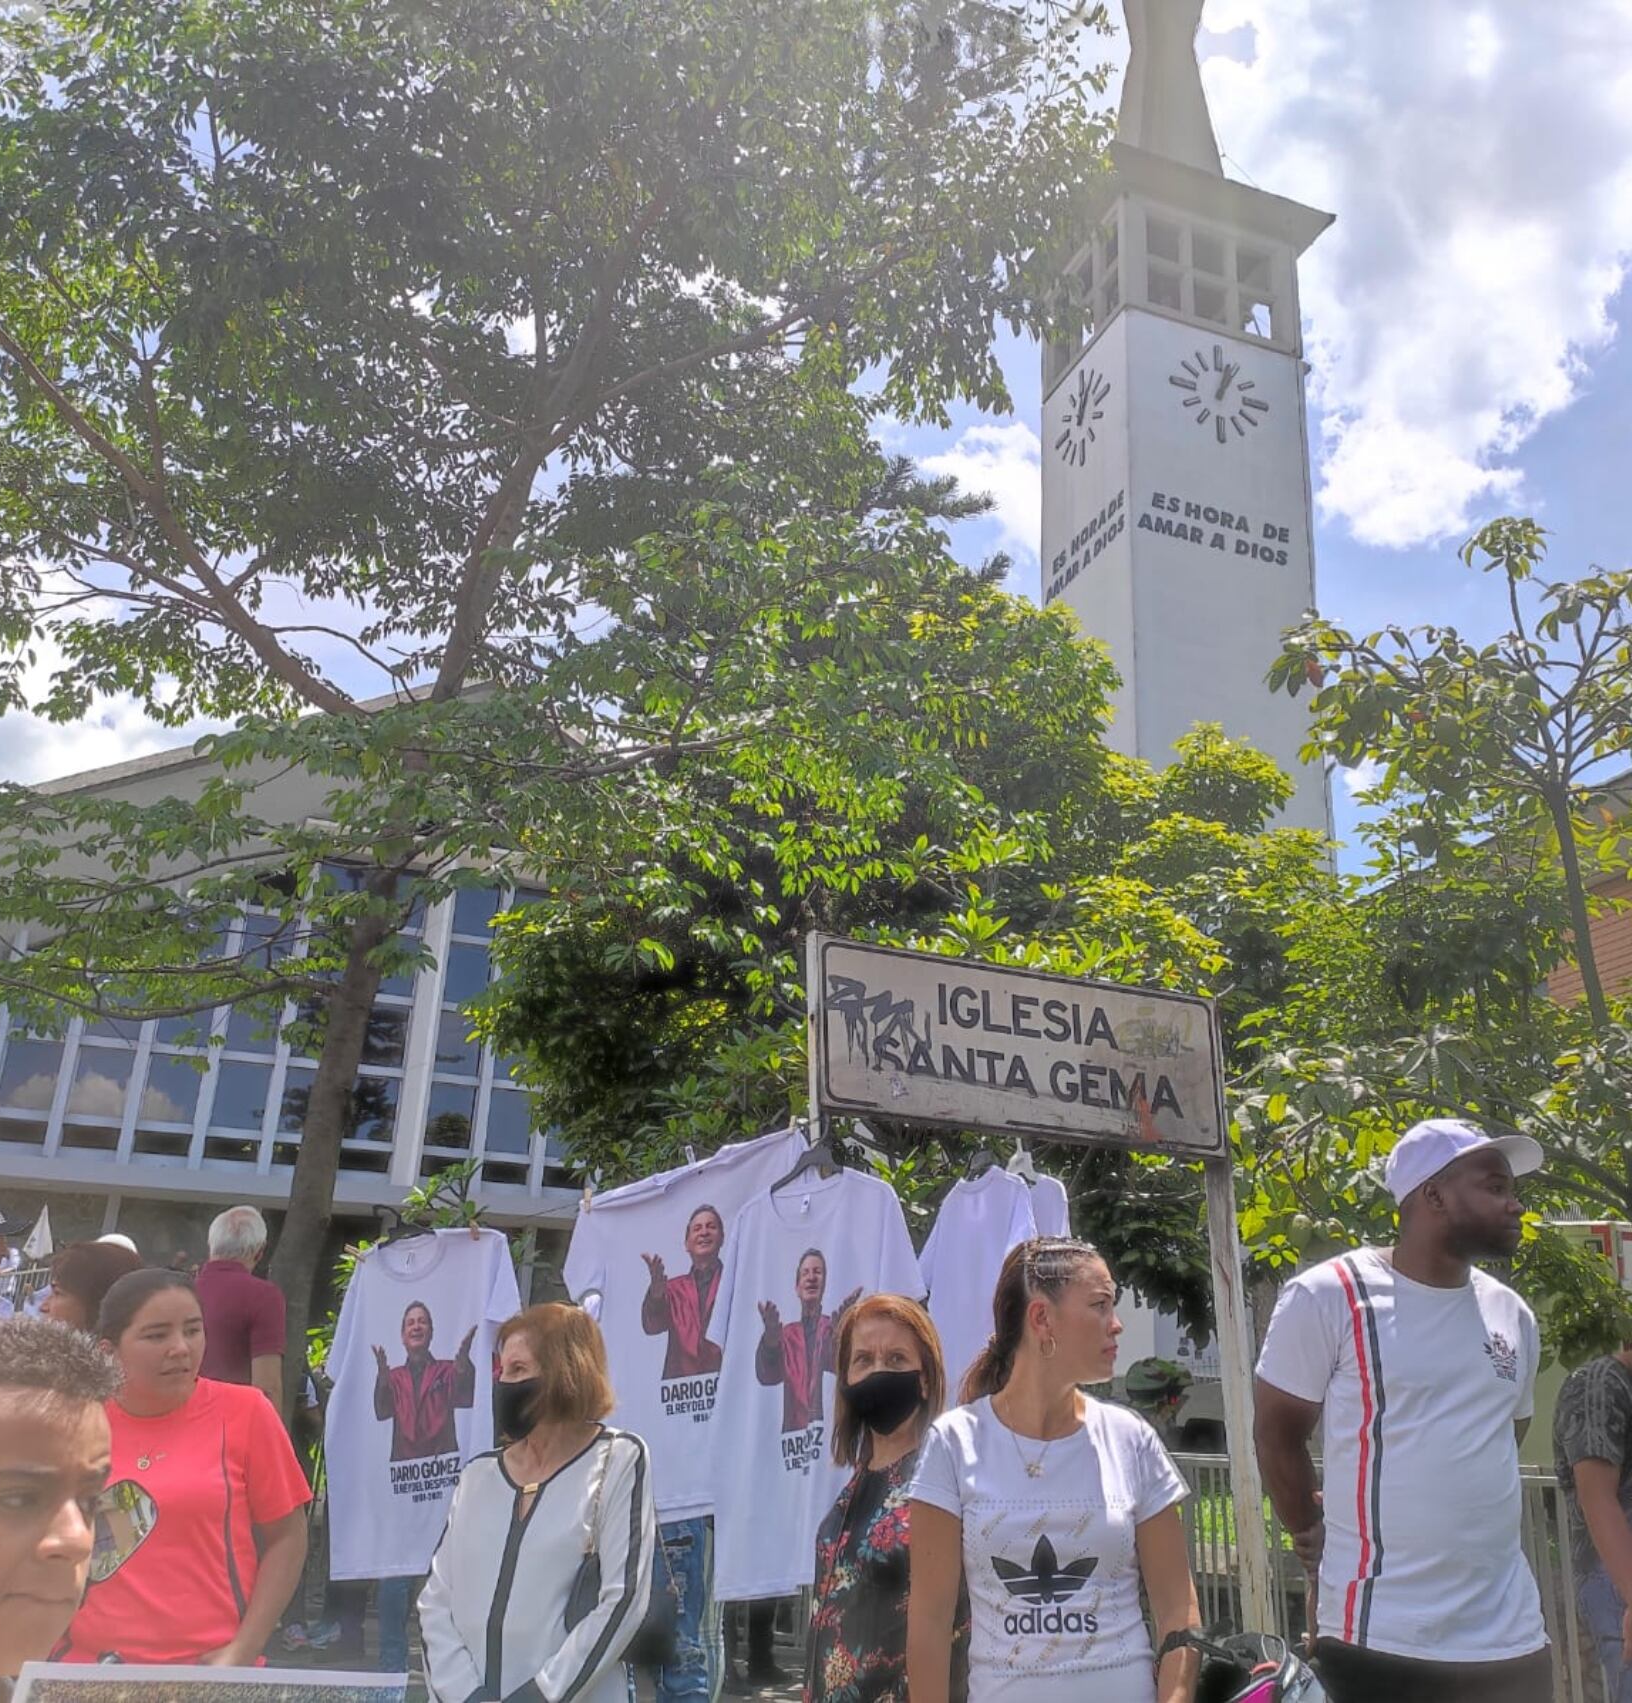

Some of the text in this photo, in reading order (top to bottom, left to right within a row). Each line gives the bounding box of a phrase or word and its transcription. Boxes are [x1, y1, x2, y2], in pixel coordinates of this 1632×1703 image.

[1081, 547, 1092, 570] A
[1094, 513, 1125, 558] DIOS
[1137, 513, 1288, 566] AMAR A DIOS
[1151, 492, 1290, 543] ES HORA DE
[1052, 549, 1067, 575] ES
[937, 983, 1119, 1051] IGLESIA
[873, 1034, 1184, 1119] SANTA GEMA
[660, 1380, 704, 1403] DARIO
[390, 1463, 421, 1483] DARIO
[1003, 1606, 1099, 1636] adidas
